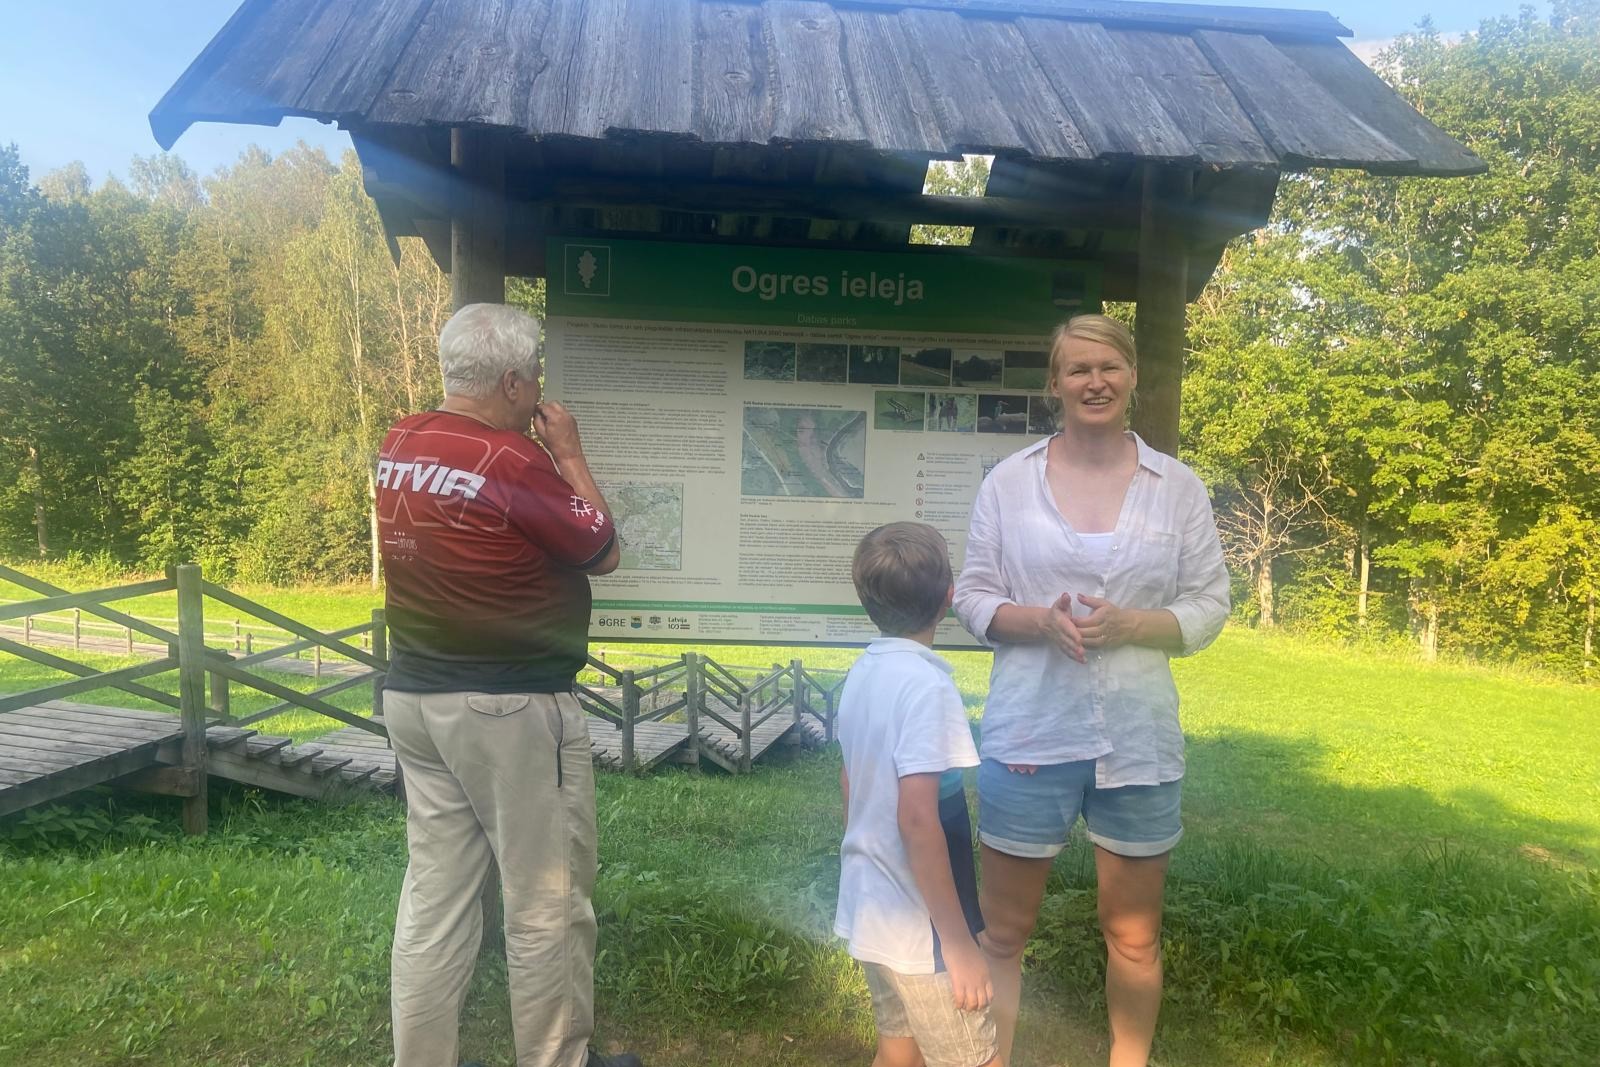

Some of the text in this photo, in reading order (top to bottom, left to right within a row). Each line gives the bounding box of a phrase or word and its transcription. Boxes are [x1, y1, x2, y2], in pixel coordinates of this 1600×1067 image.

[731, 265, 924, 306] Ogres ieleja
[797, 314, 857, 328] Dabas parks
[376, 460, 486, 499] ATVIA
